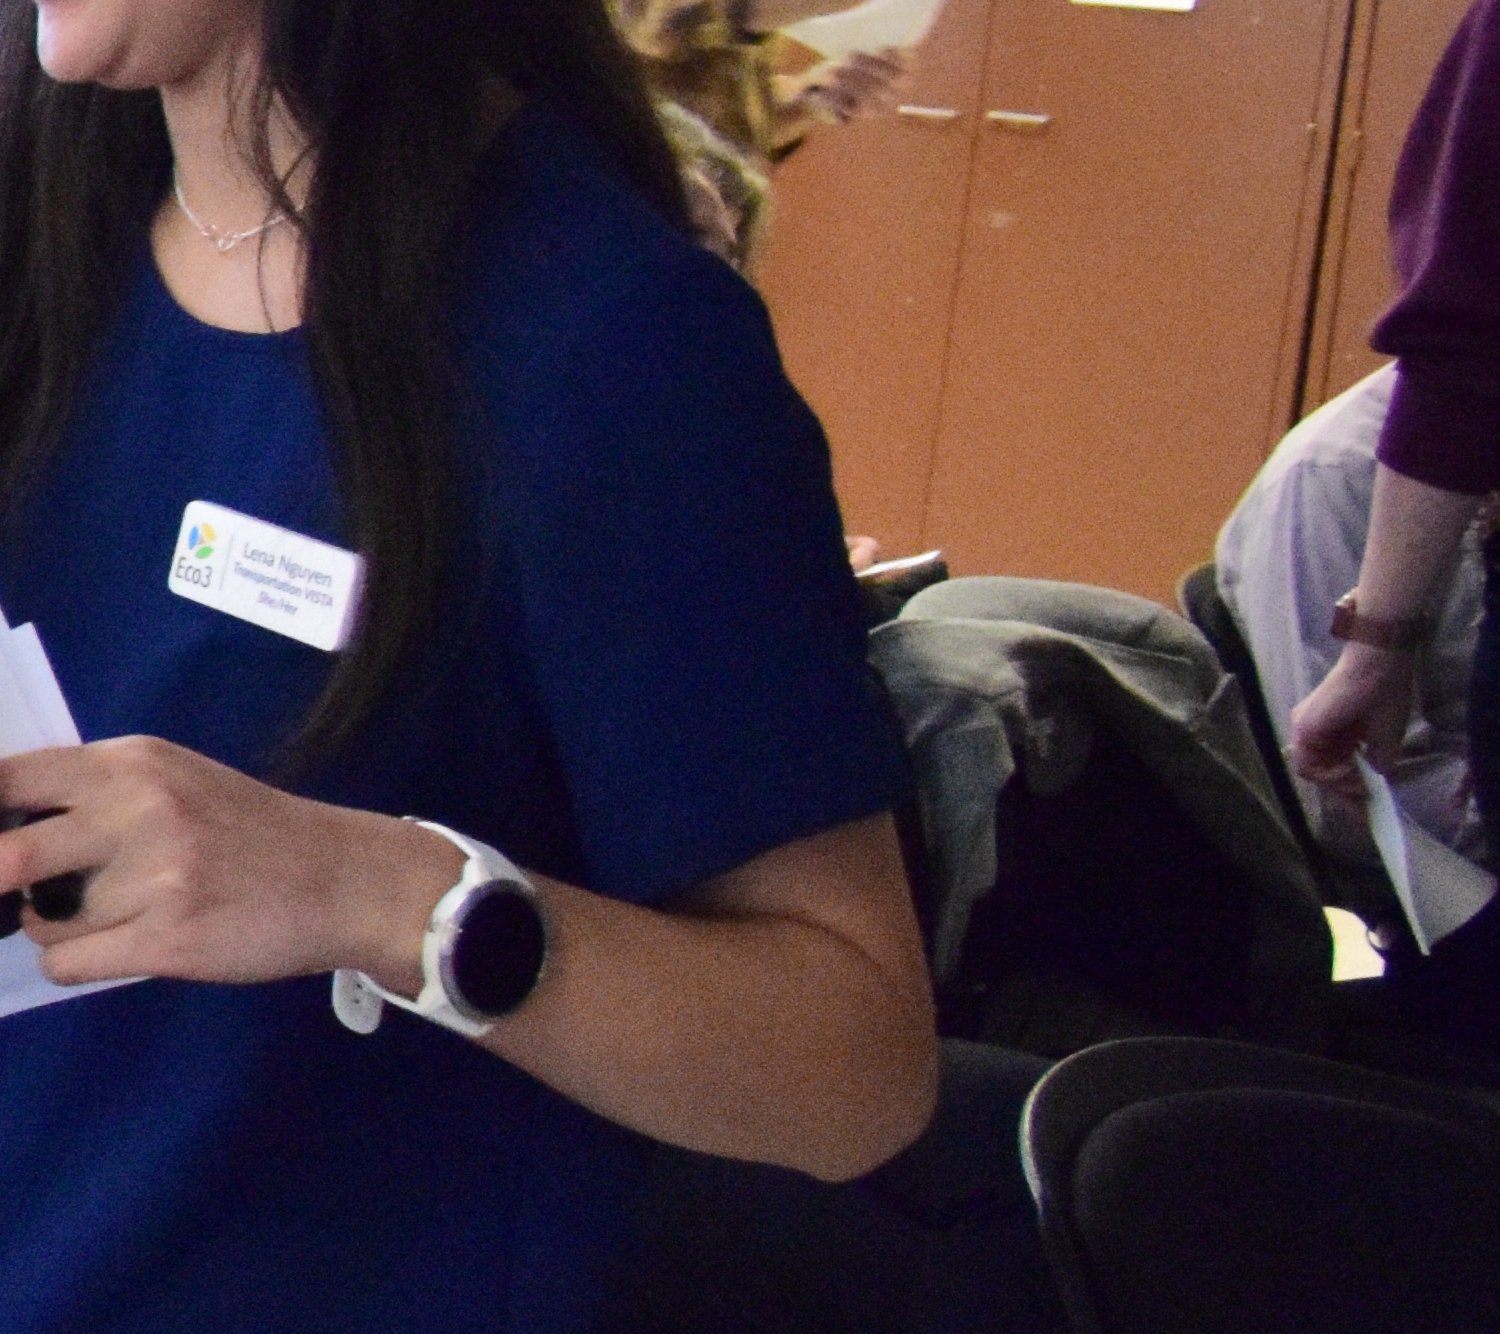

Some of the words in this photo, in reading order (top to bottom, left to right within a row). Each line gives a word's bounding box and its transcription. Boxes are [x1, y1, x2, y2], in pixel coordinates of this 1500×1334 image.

[175, 556, 213, 588] Eco3
[233, 561, 303, 598] Transportation
[303, 587, 334, 608] VISTA
[243, 542, 275, 567] Lena
[278, 556, 333, 587] Nguyen
